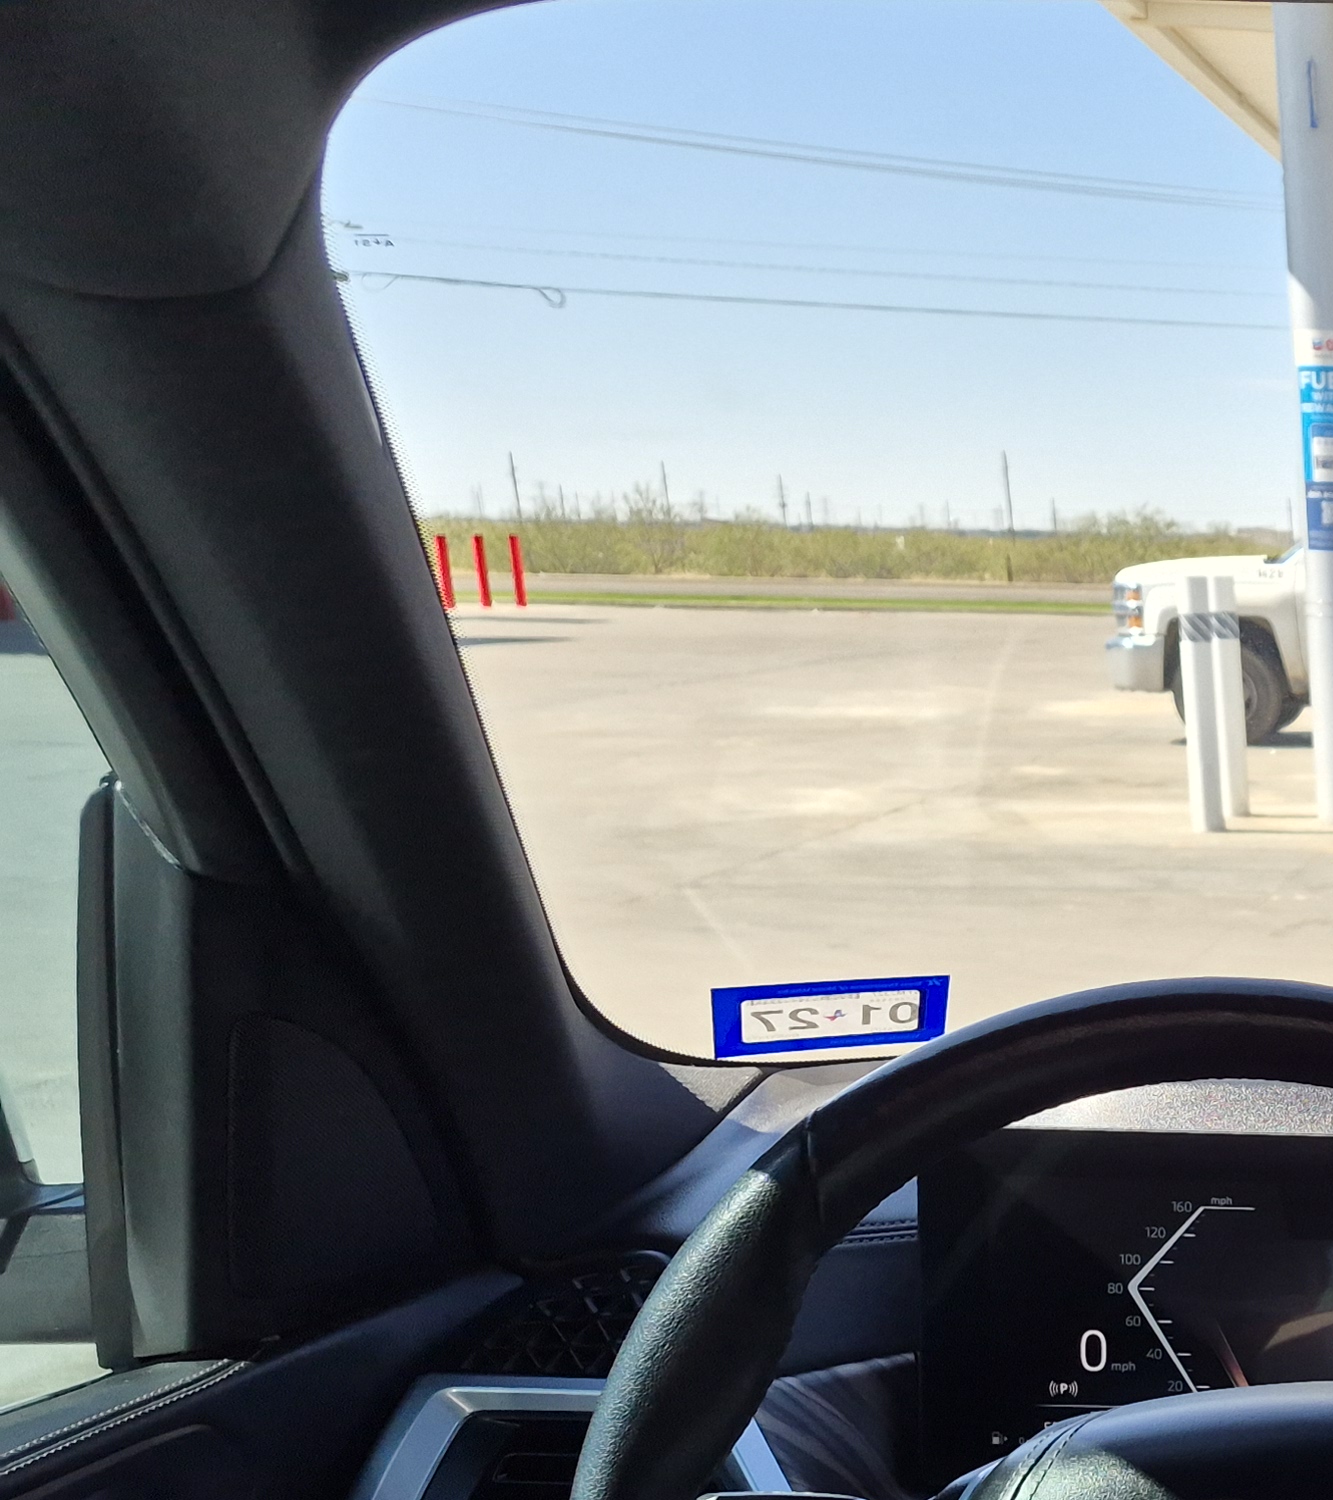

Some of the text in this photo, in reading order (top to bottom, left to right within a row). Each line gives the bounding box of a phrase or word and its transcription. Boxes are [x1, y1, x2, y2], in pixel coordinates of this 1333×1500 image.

[1172, 1202, 1193, 1213] 160
[1210, 1196, 1233, 1208] mph
[1145, 1227, 1166, 1238] 120
[1119, 1254, 1141, 1265] 100
[1107, 1283, 1124, 1294] 80
[1125, 1316, 1141, 1327] 60
[1079, 1330, 1108, 1373] 0
[1146, 1349, 1162, 1360] 40
[1111, 1361, 1136, 1375] mph
[1168, 1380, 1184, 1392] 20
